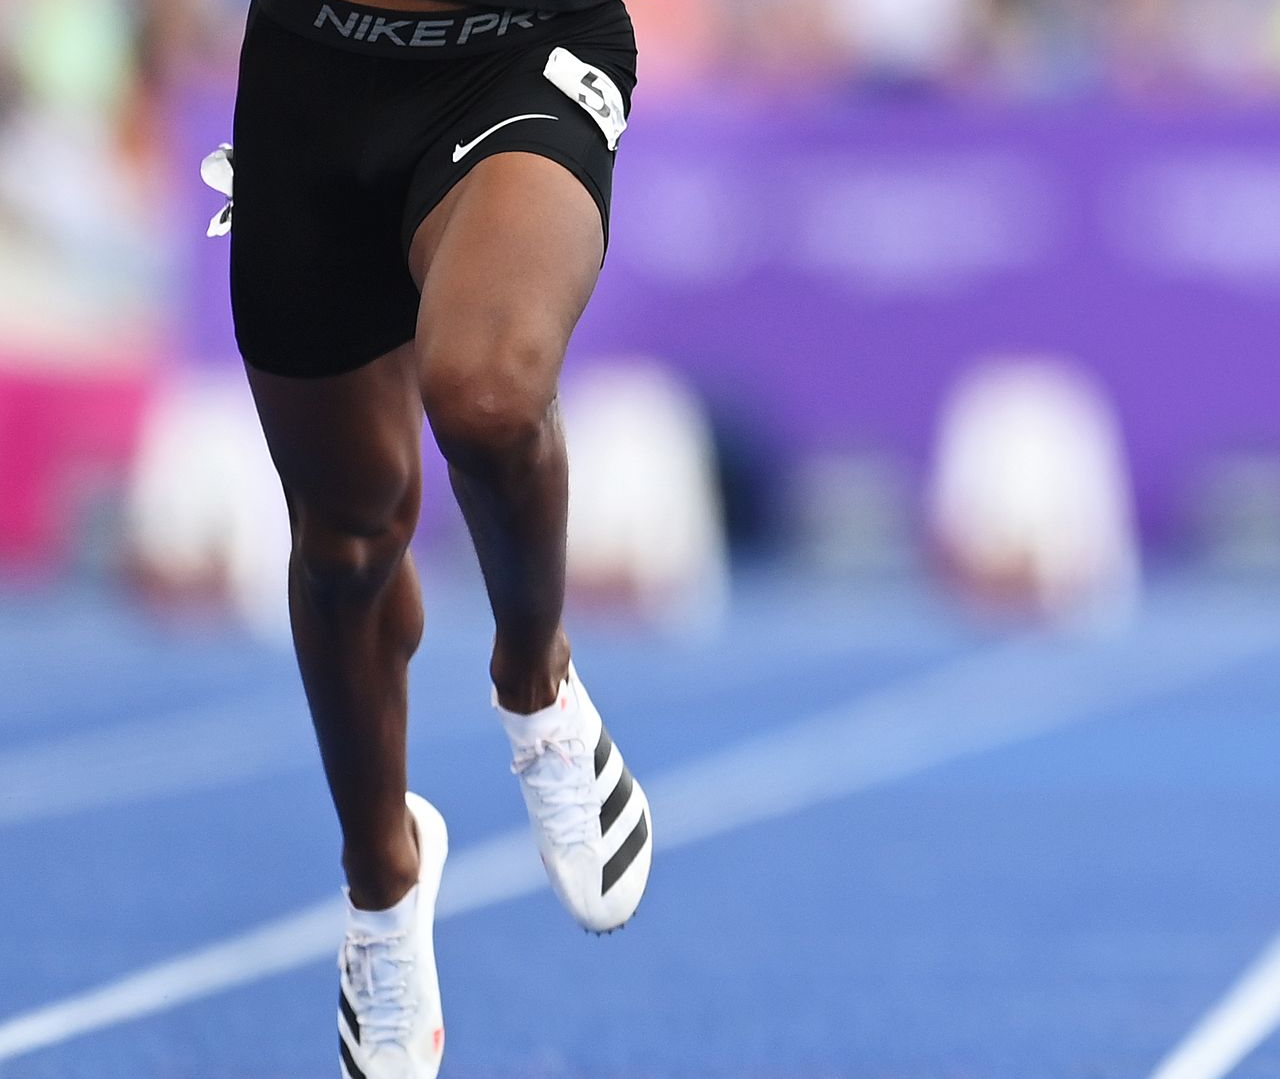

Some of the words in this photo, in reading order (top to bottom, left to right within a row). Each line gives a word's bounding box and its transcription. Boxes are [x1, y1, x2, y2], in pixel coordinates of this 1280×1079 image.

[313, 4, 454, 47] NIKE
[455, 8, 557, 45] PR
[578, 71, 611, 118] 5
